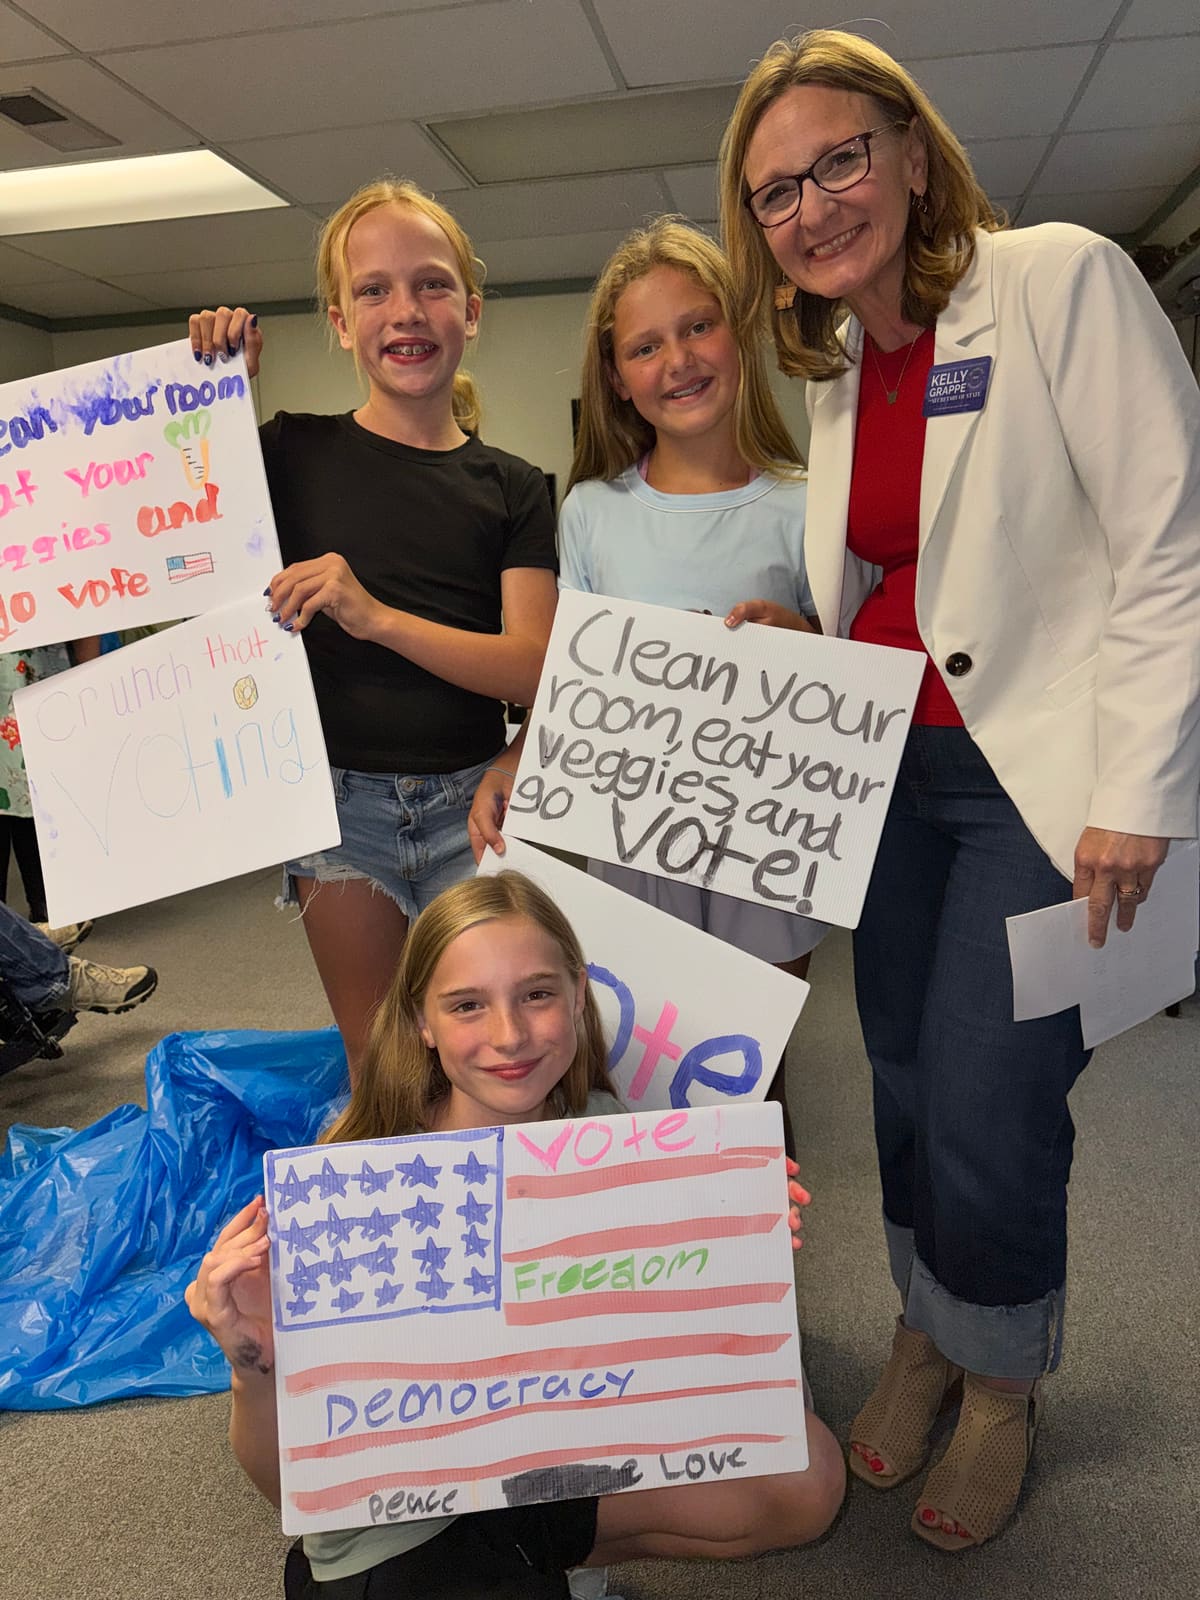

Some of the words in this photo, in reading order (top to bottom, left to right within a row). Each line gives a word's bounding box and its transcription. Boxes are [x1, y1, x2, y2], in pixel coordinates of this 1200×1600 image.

[68, 385, 159, 436] your
[164, 374, 246, 415] room
[929, 383, 967, 398] GRAPPE
[931, 369, 969, 387] KELLY
[0, 469, 39, 518] at
[64, 452, 154, 498] your
[0, 521, 112, 572] ggies
[136, 482, 223, 538] and
[202, 627, 269, 669] that
[568, 609, 738, 705] Clean
[741, 670, 906, 743] your
[692, 717, 782, 778] eat
[772, 751, 886, 804] your
[509, 775, 574, 820] go
[745, 798, 842, 861] and
